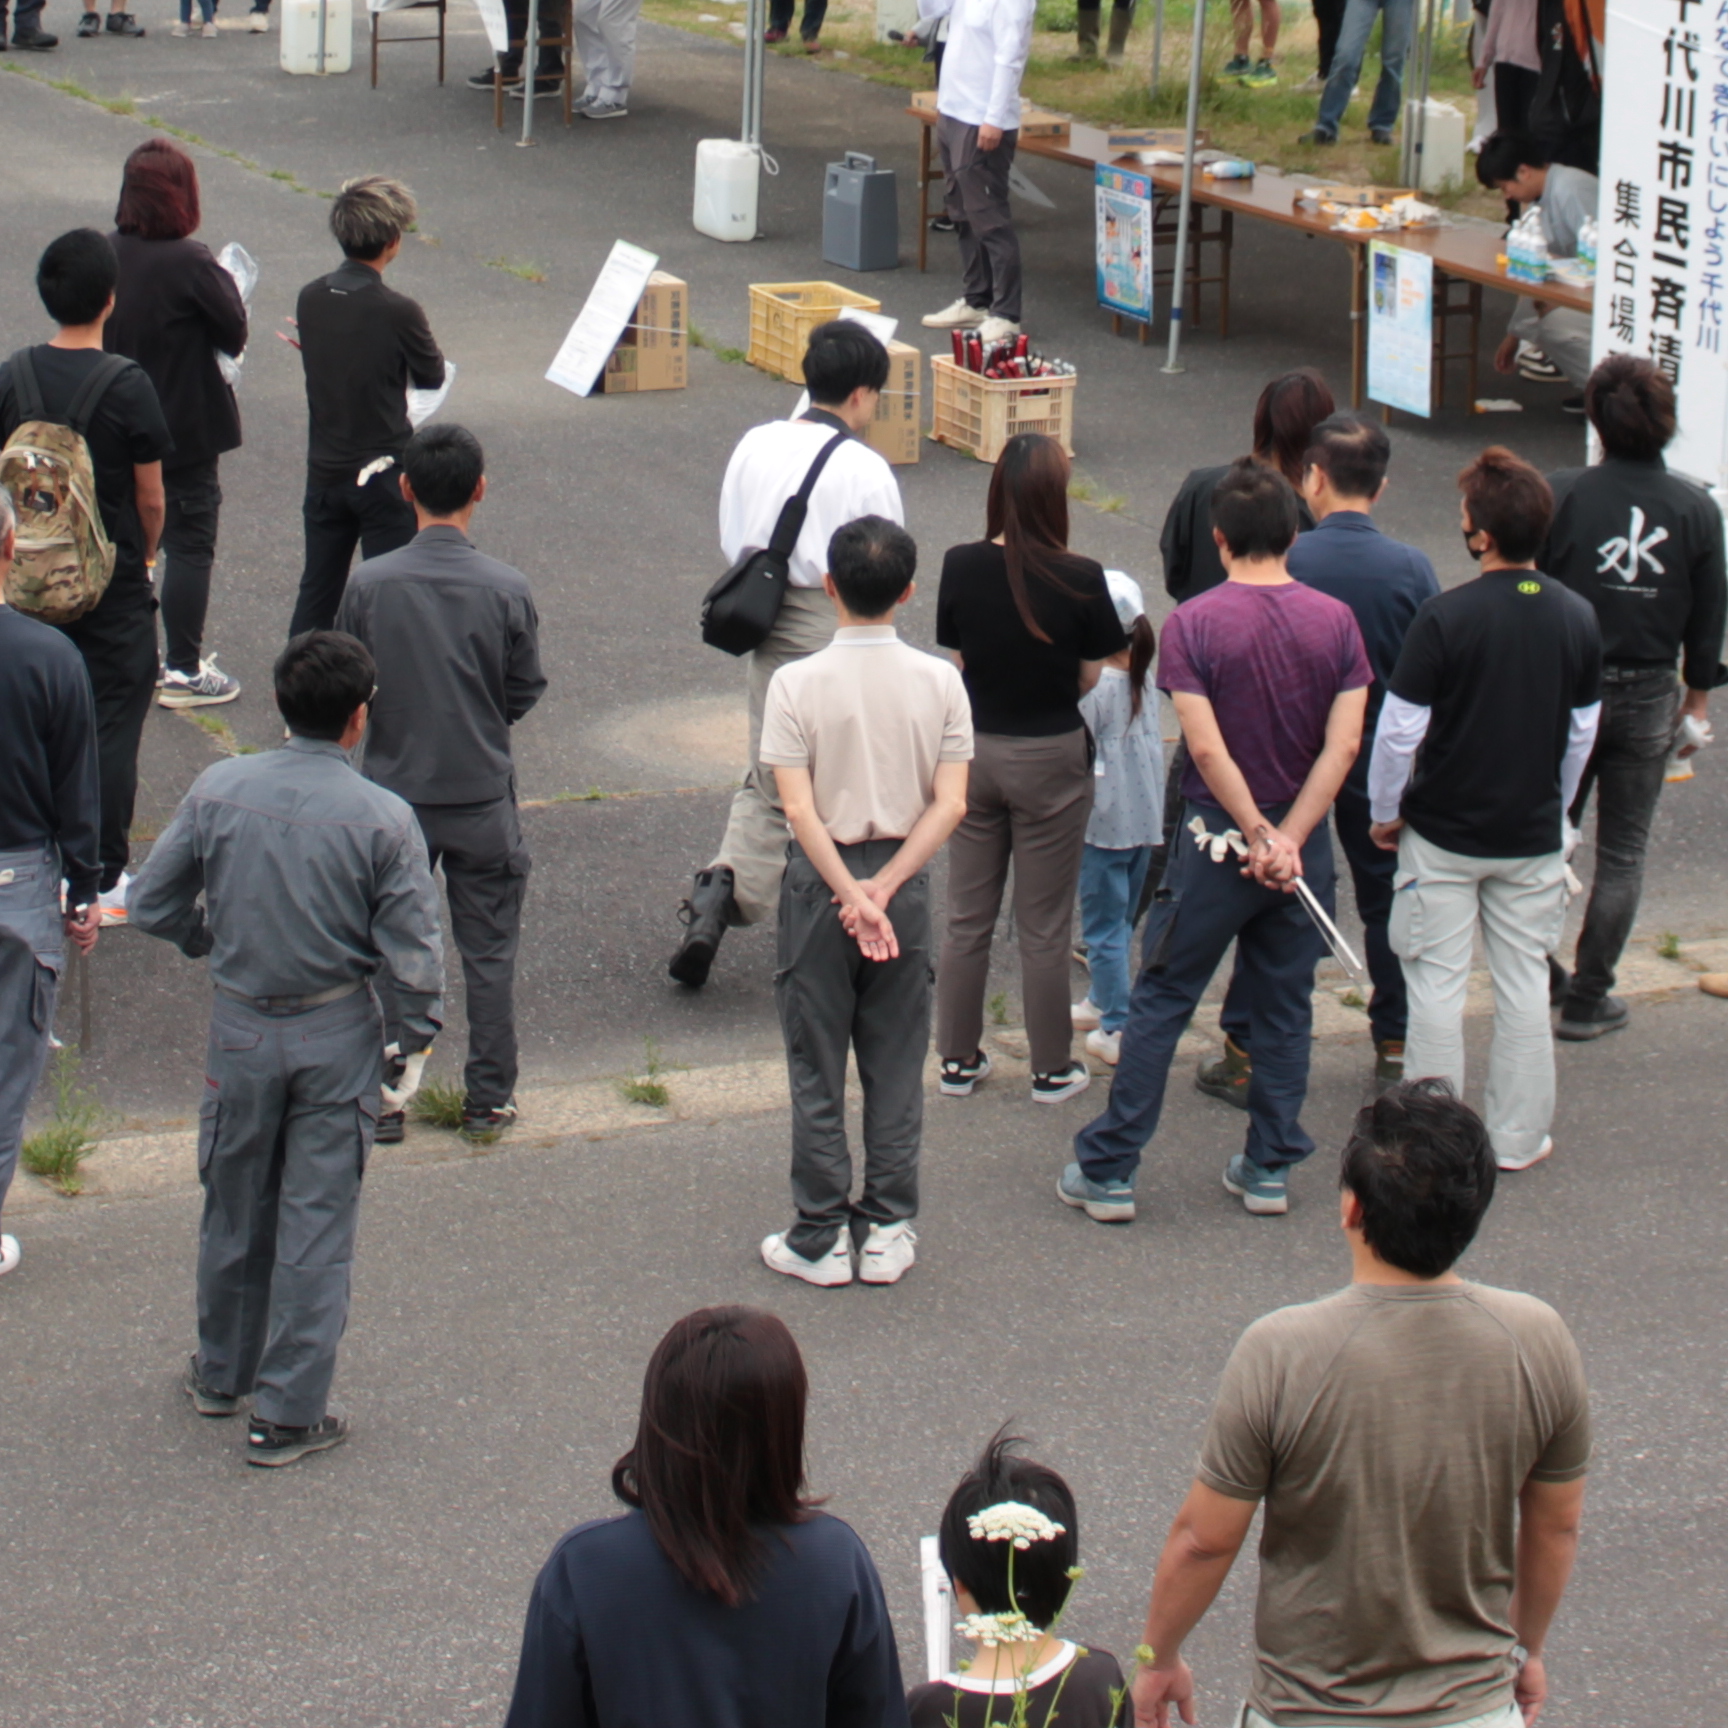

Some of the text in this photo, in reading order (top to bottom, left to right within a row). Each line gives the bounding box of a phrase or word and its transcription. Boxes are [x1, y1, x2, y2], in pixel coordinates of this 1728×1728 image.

[1608, 178, 1641, 357] 集合場
[1597, 505, 1669, 584] 水
